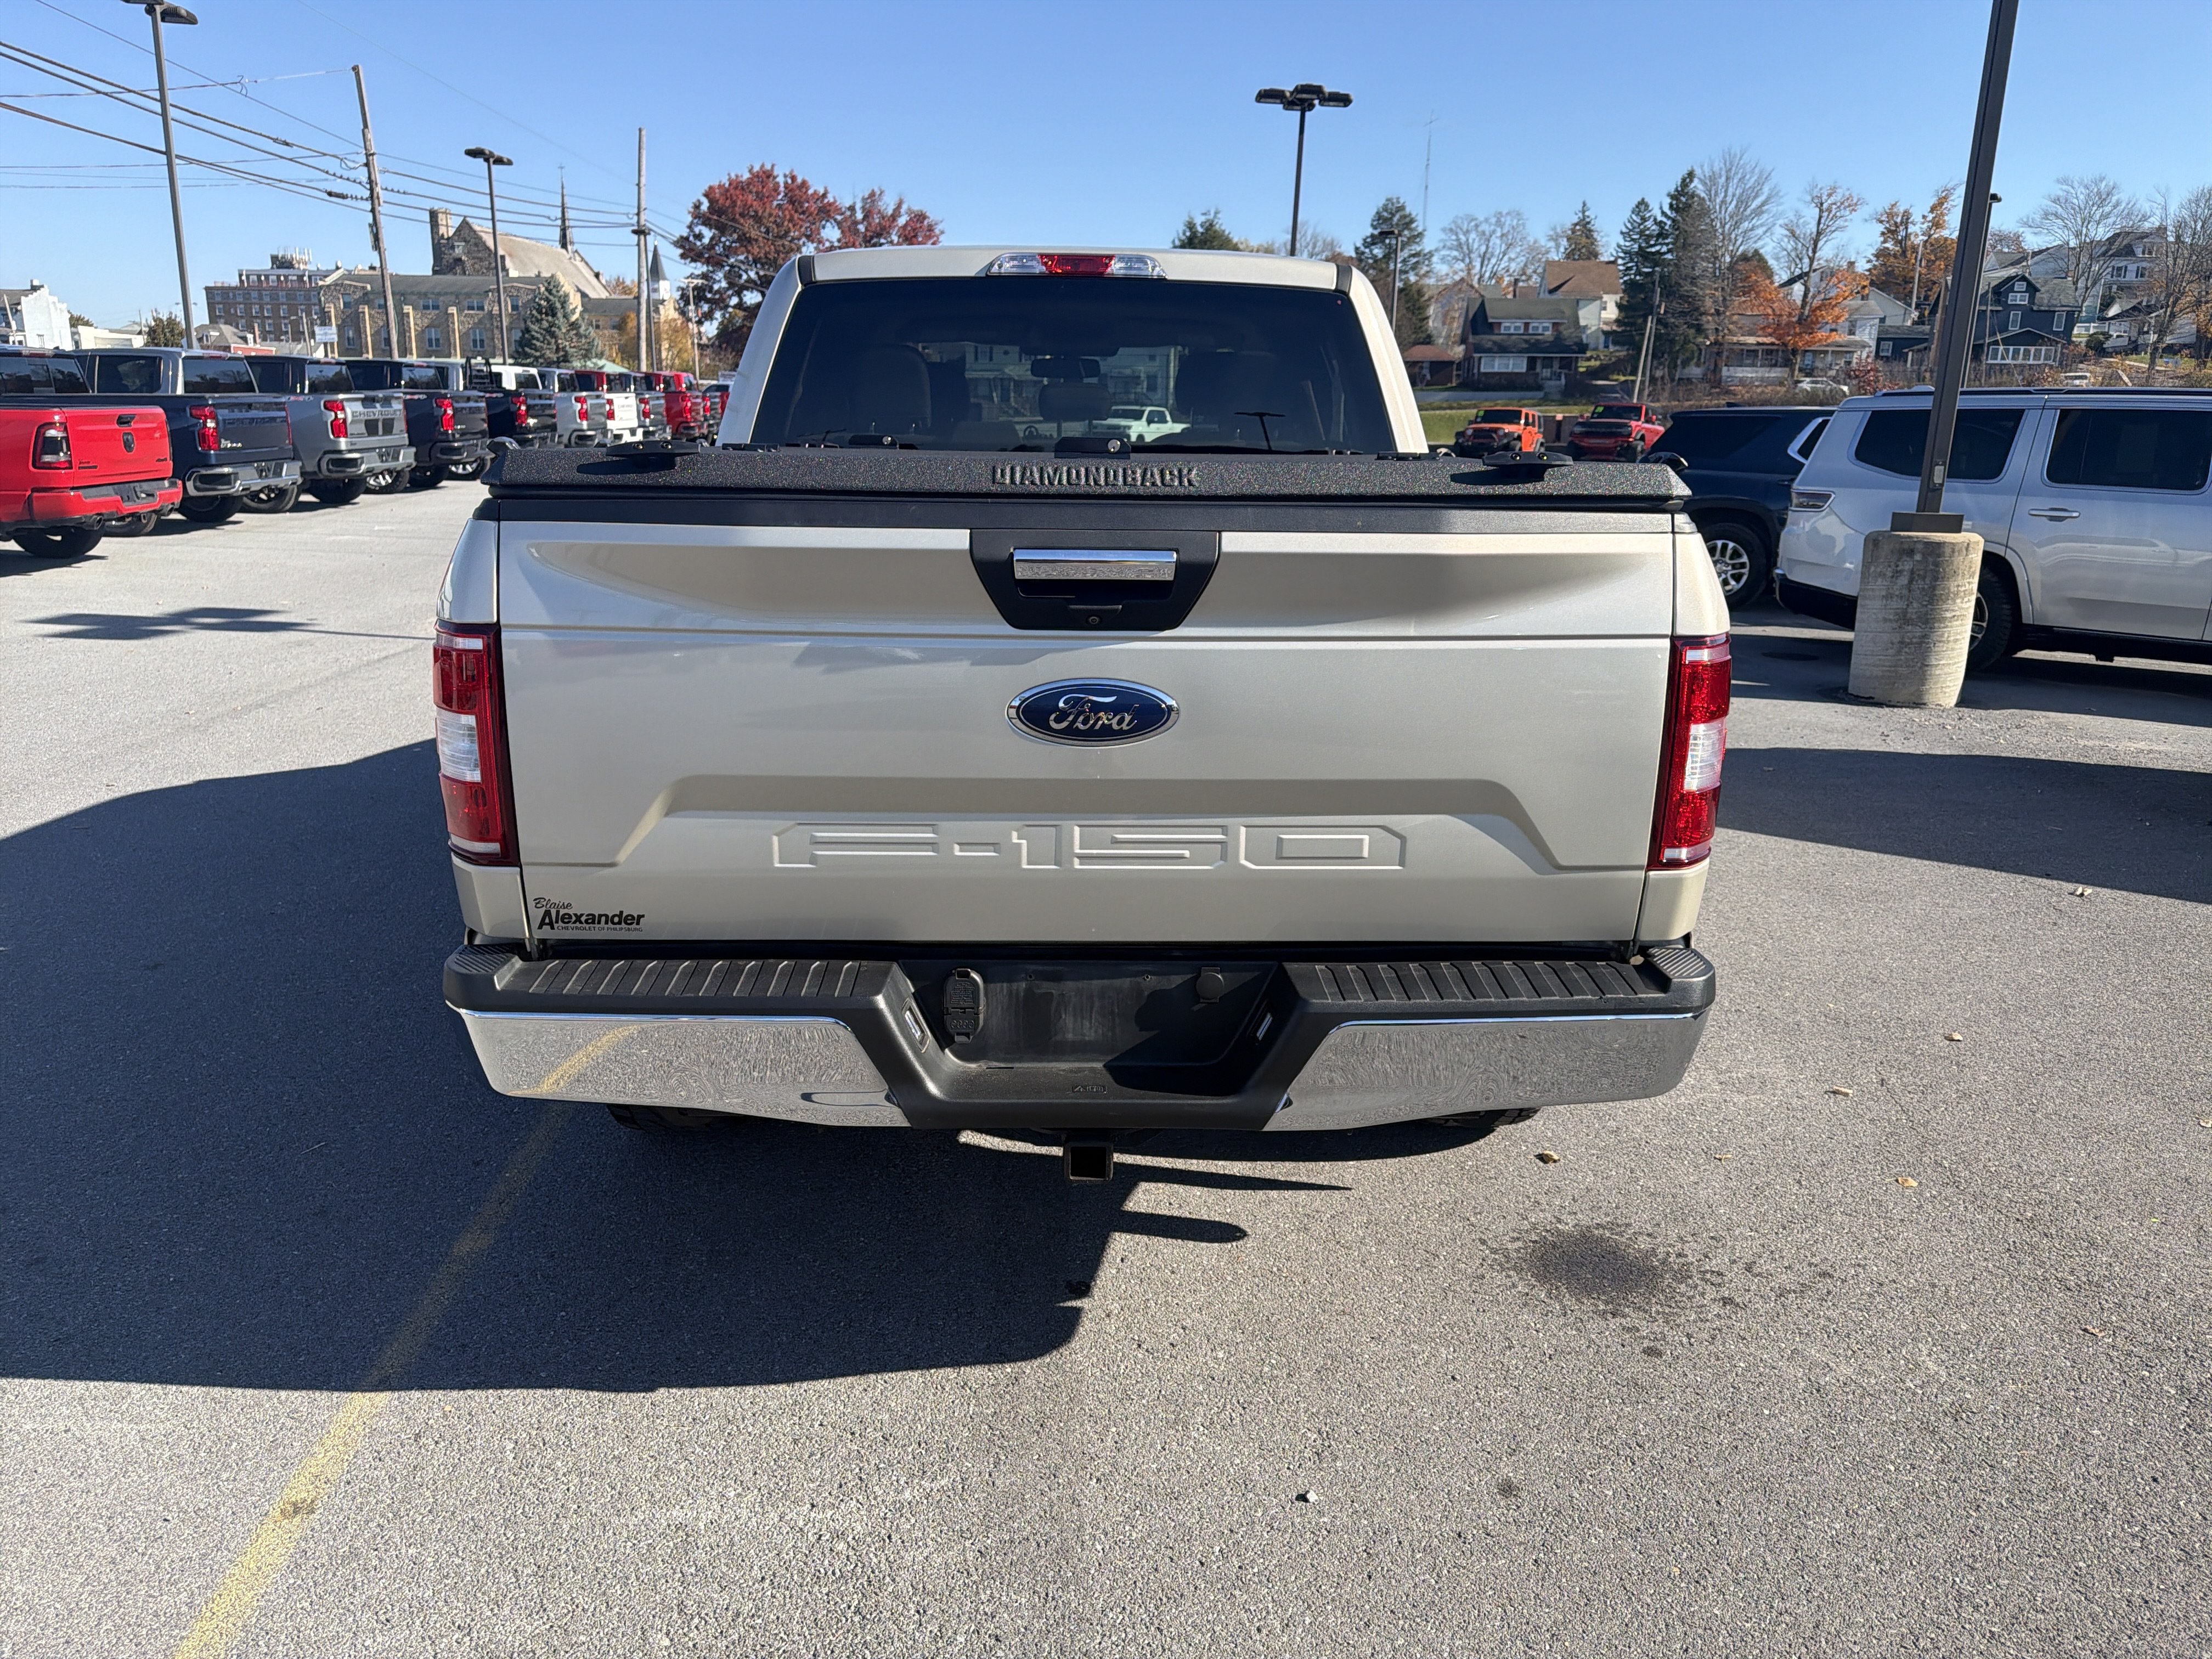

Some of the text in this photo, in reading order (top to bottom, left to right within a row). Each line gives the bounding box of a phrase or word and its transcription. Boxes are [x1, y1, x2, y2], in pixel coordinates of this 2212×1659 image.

[992, 465, 1198, 487] DIAMONDBACK
[1048, 693, 1139, 730] Ford
[773, 822, 1406, 870] F-150
[533, 897, 573, 910] Blaise
[537, 910, 645, 930] Alexander
